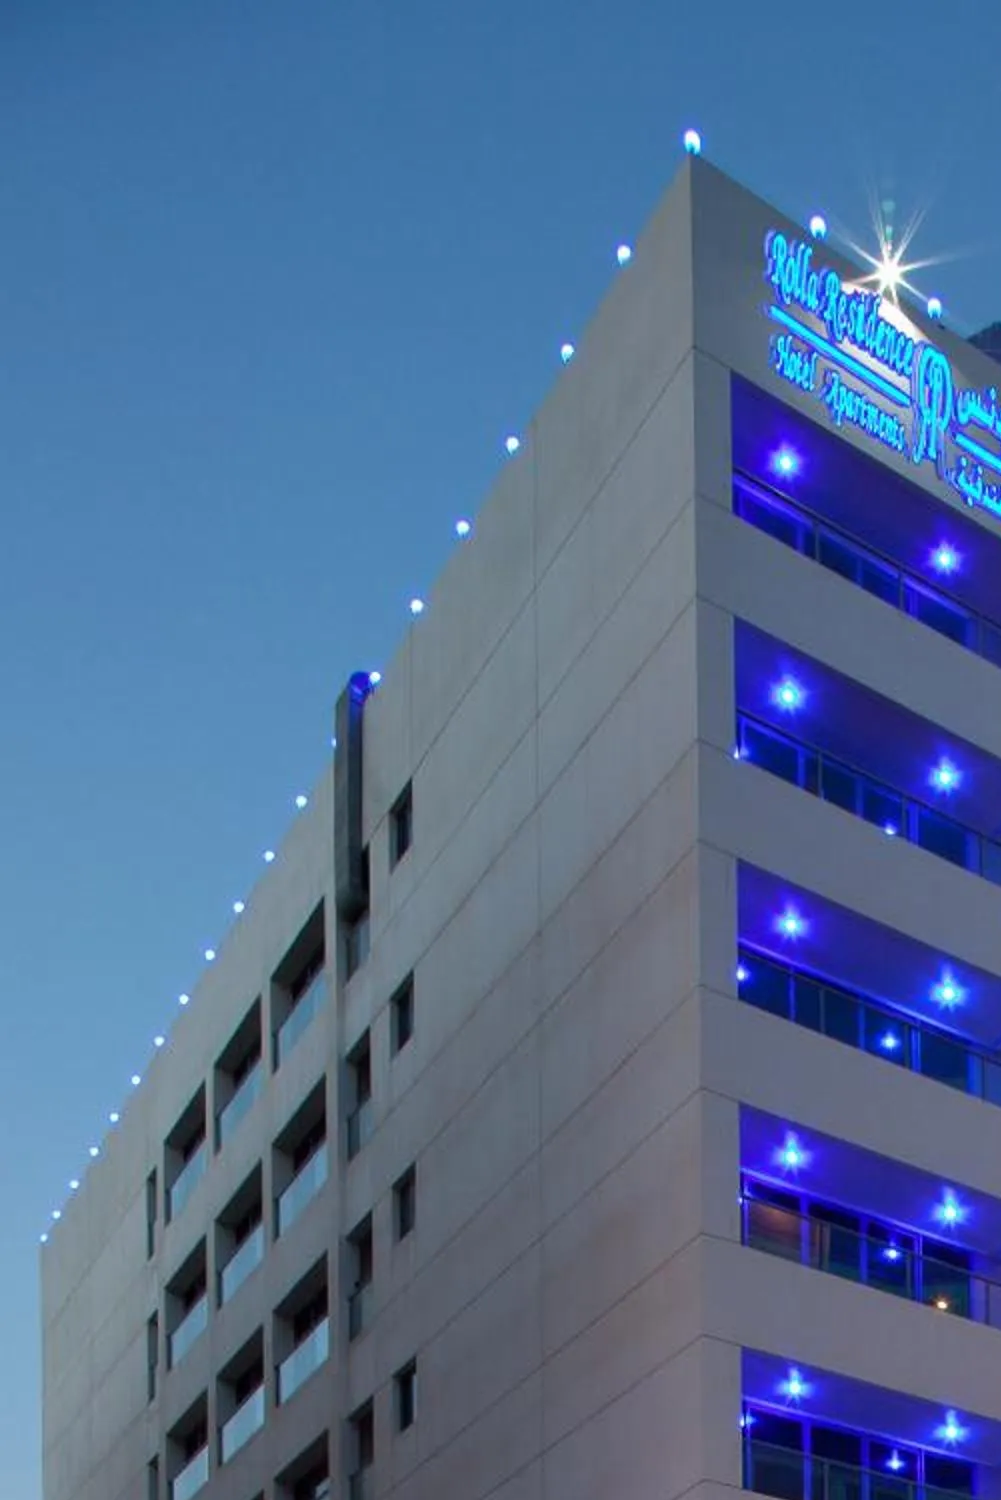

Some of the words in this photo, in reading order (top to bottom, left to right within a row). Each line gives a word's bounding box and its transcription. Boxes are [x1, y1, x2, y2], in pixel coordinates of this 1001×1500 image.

[766, 231, 819, 312] Rolla
[820, 270, 914, 377] Residence
[770, 333, 818, 391] Hotel
[820, 369, 906, 452] Apartments
